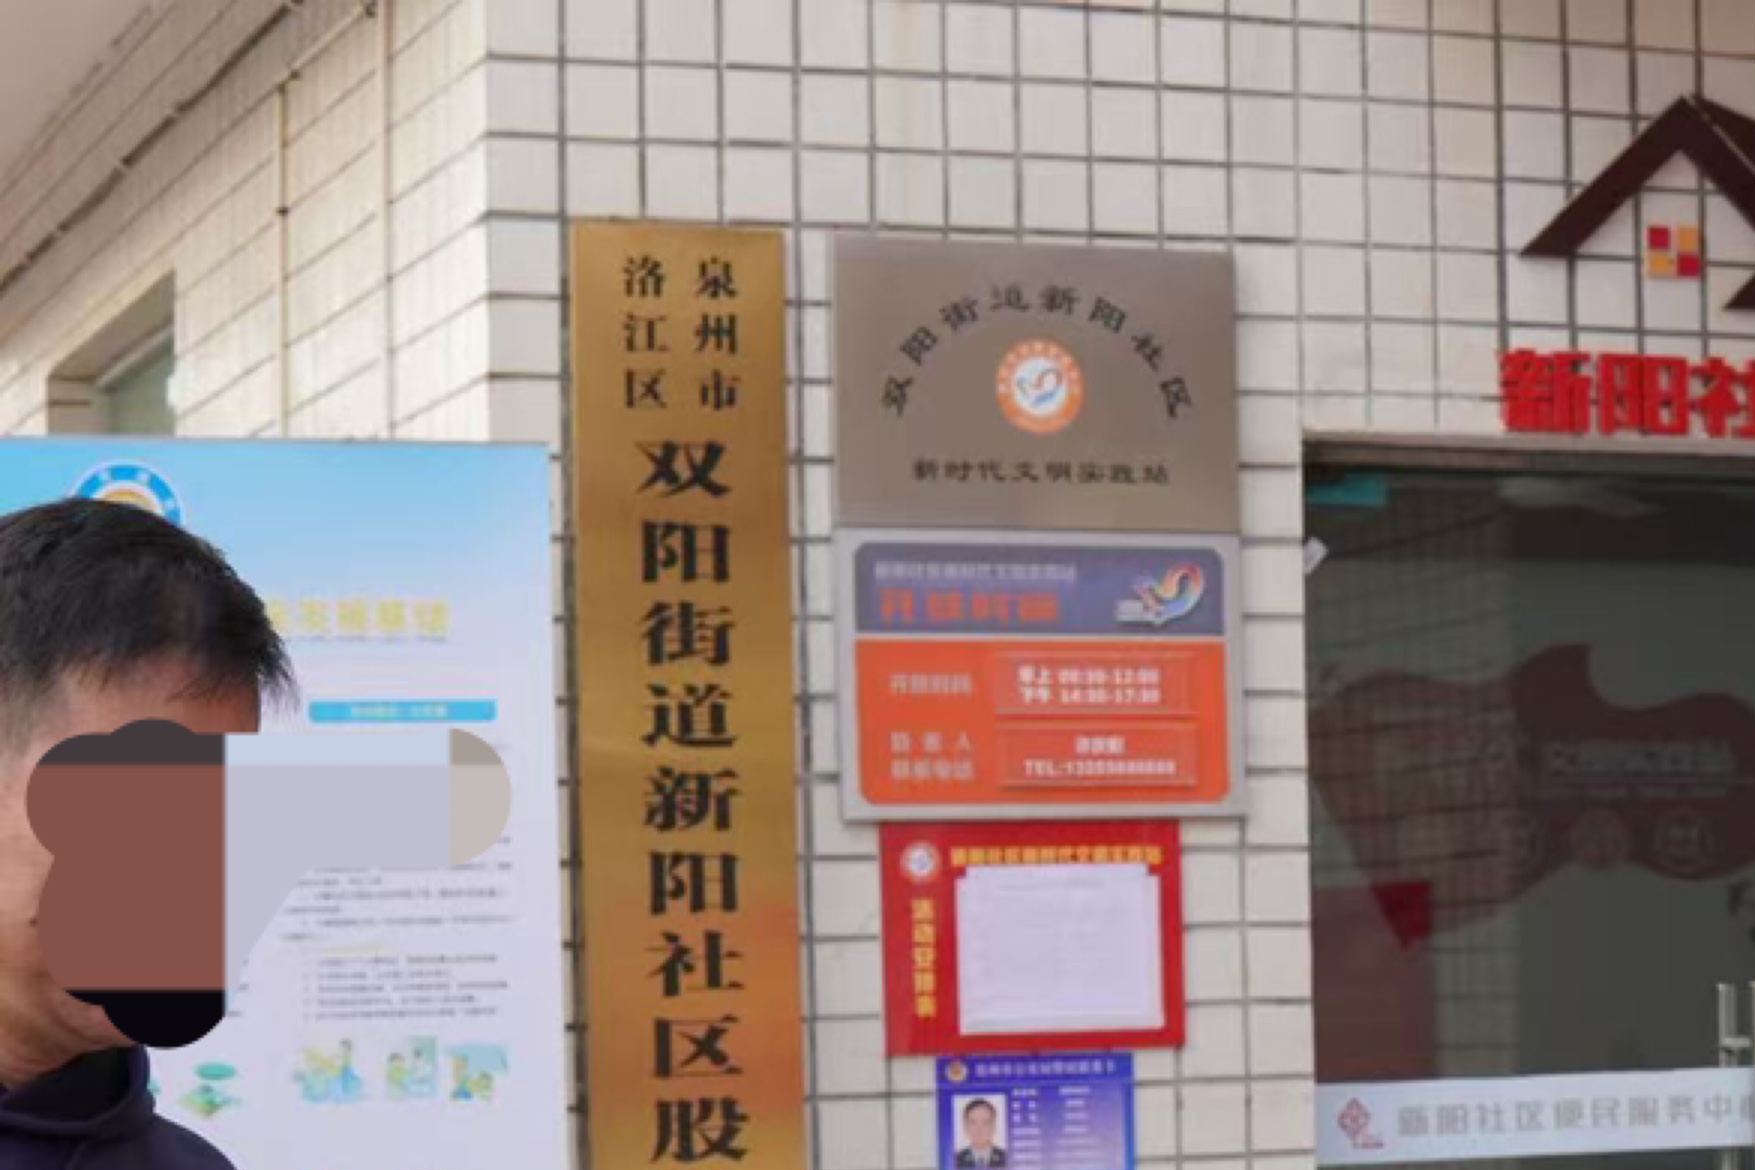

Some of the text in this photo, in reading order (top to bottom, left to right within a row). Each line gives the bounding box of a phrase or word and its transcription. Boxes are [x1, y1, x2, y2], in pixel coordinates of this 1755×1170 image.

[622, 255, 669, 410] 洛江区
[694, 254, 740, 411] 泉州市
